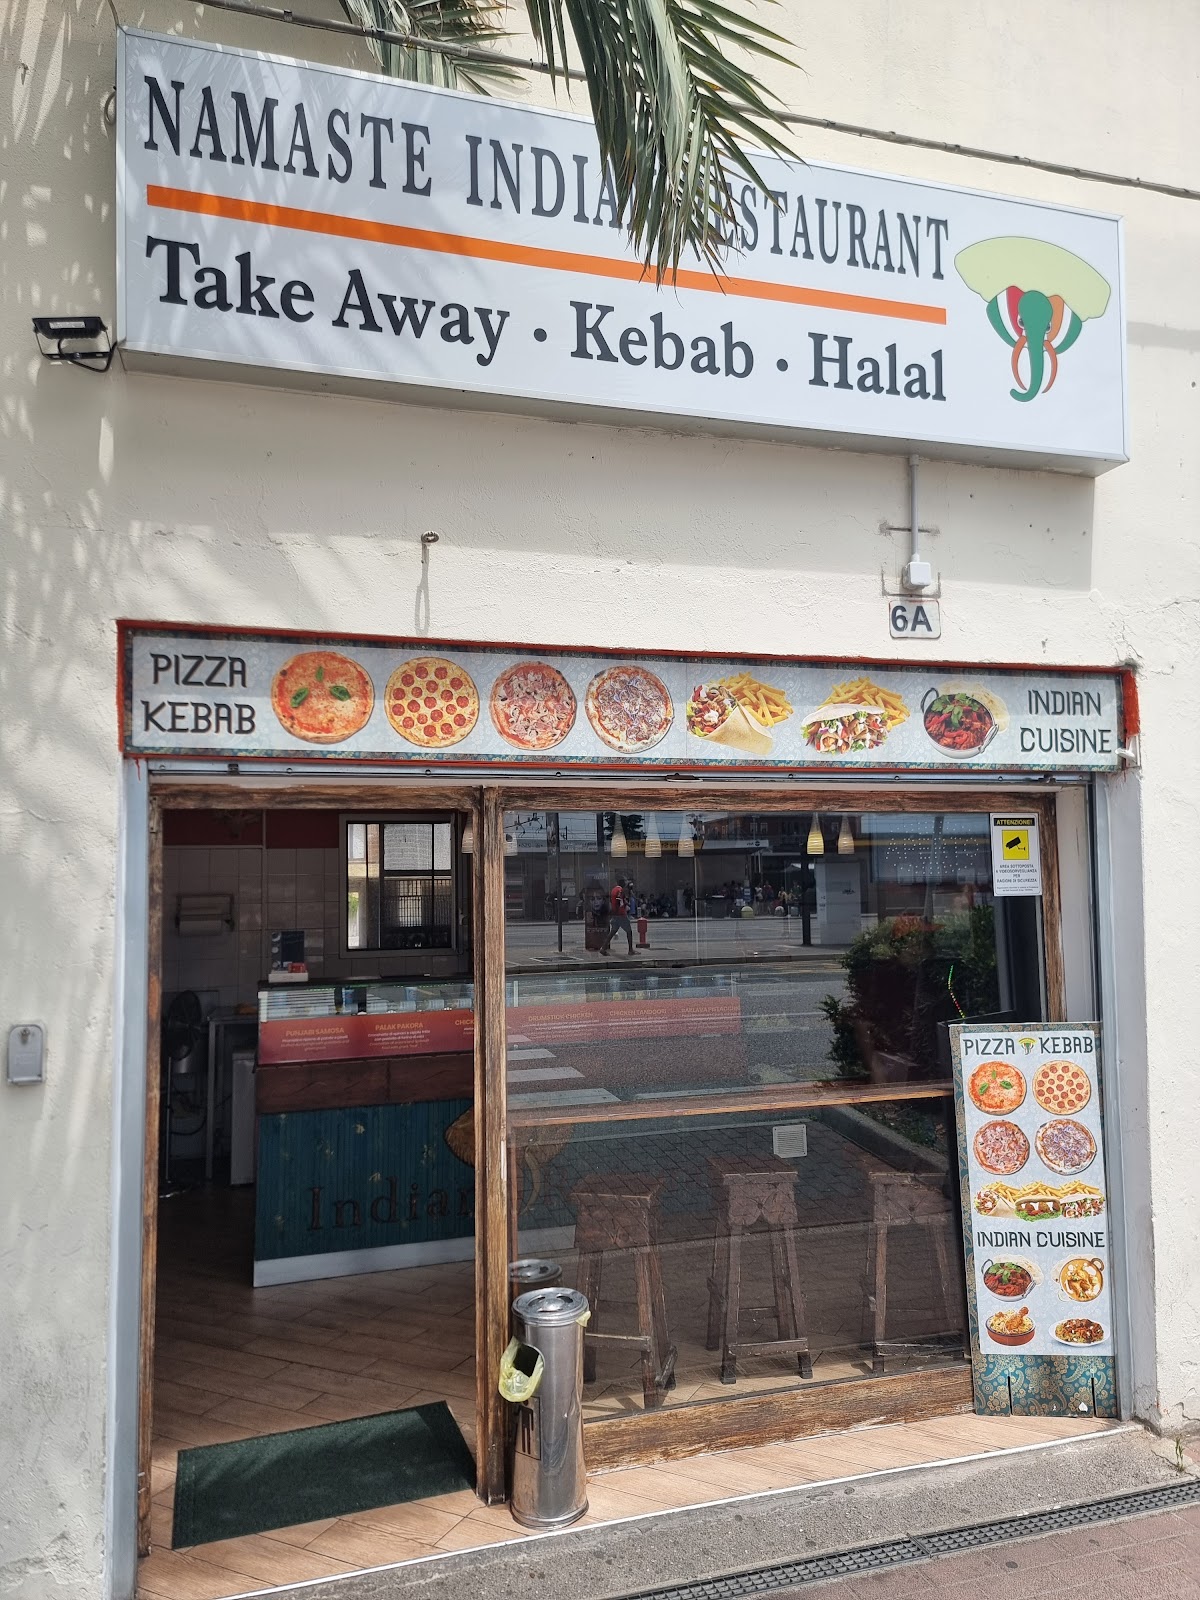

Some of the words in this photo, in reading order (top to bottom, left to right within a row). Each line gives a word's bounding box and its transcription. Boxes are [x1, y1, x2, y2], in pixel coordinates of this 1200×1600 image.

[143, 76, 432, 196] NAMASTE
[465, 134, 657, 233] INDIA
[682, 172, 948, 280] ESTAURANT
[145, 235, 315, 323] Take
[332, 269, 510, 365] Away
[570, 301, 754, 378] Kebab
[808, 332, 946, 401] Halal
[891, 605, 932, 632] 6A
[149, 652, 247, 688] PIZZA
[140, 699, 256, 735] KEBAB
[1028, 689, 1101, 717] INDIAN
[1019, 728, 1112, 754] CUISINE
[962, 1037, 1016, 1056] PIZZA
[1038, 1036, 1094, 1054] KEBAB
[976, 1231, 1032, 1248] INDIAN
[1036, 1231, 1106, 1248] CUISINE
